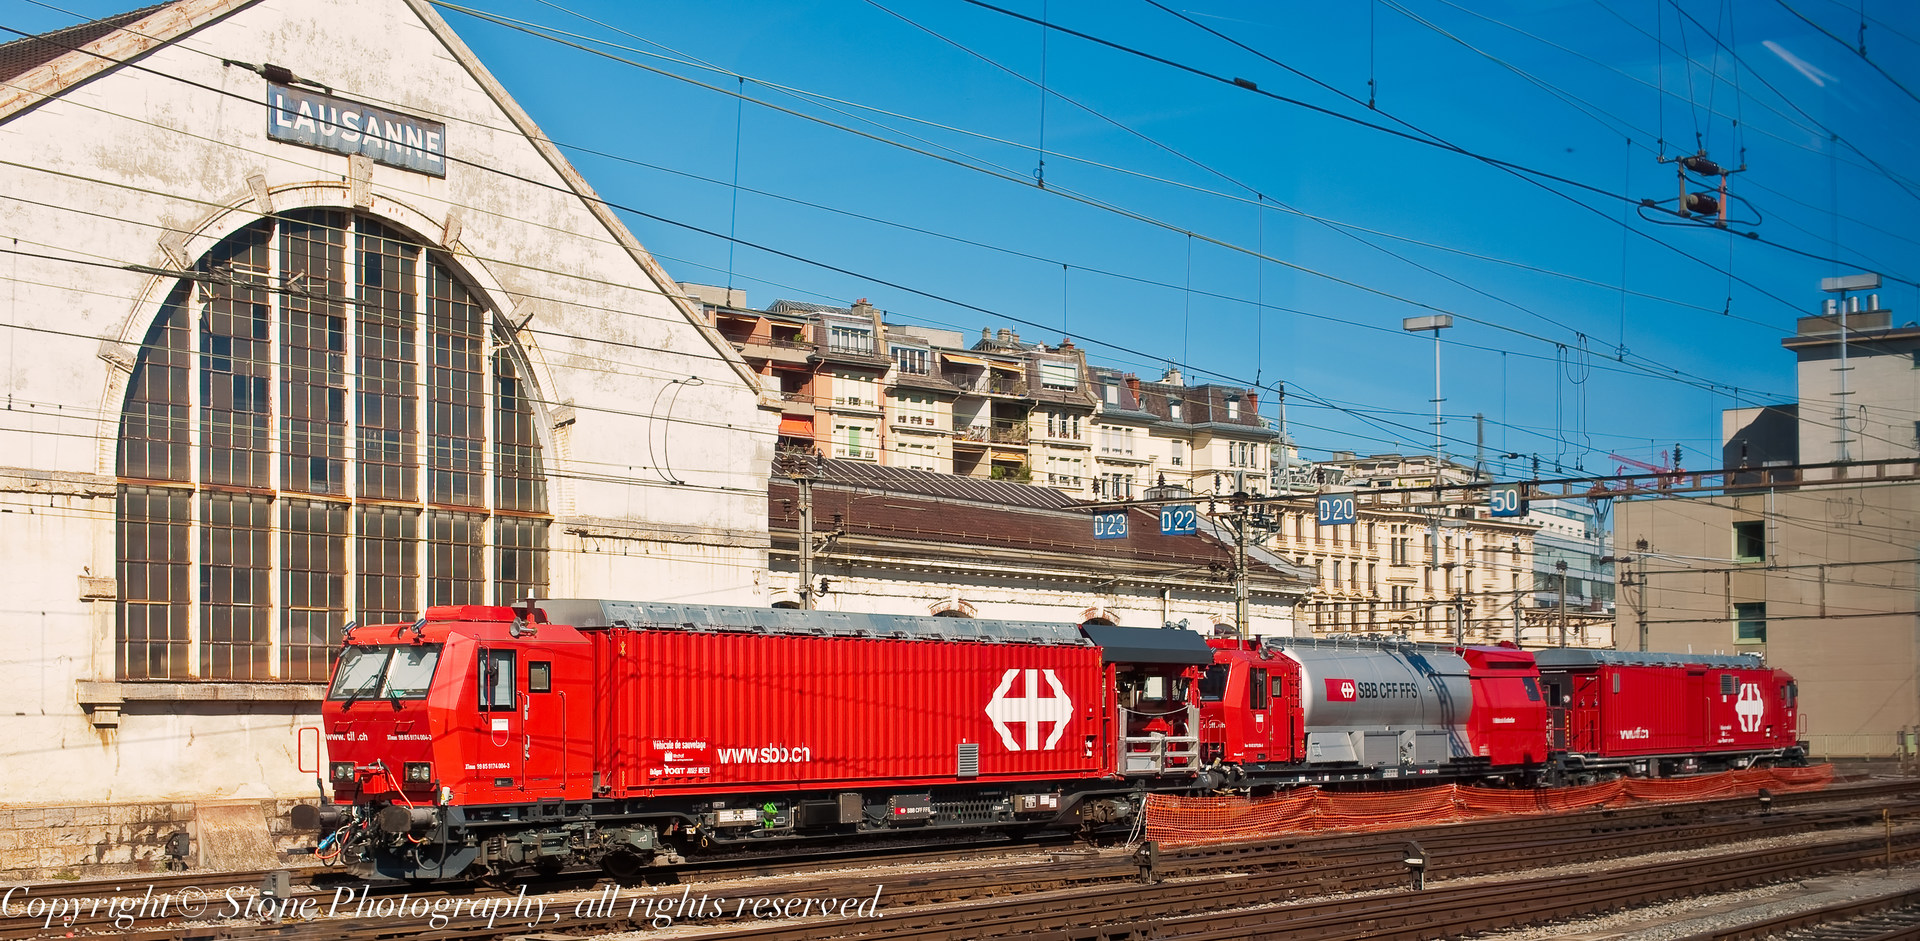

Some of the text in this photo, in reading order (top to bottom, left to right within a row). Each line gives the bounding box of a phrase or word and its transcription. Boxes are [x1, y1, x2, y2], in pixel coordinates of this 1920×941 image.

[276, 94, 441, 163] LAUSANNE
[1320, 498, 1354, 521] D20
[1492, 489, 1518, 512] 50
[1094, 513, 1126, 536] D23
[1161, 510, 1195, 532] D22
[1358, 682, 1417, 699] SBB CFF FFS
[717, 742, 810, 764] www.sbb.ch
